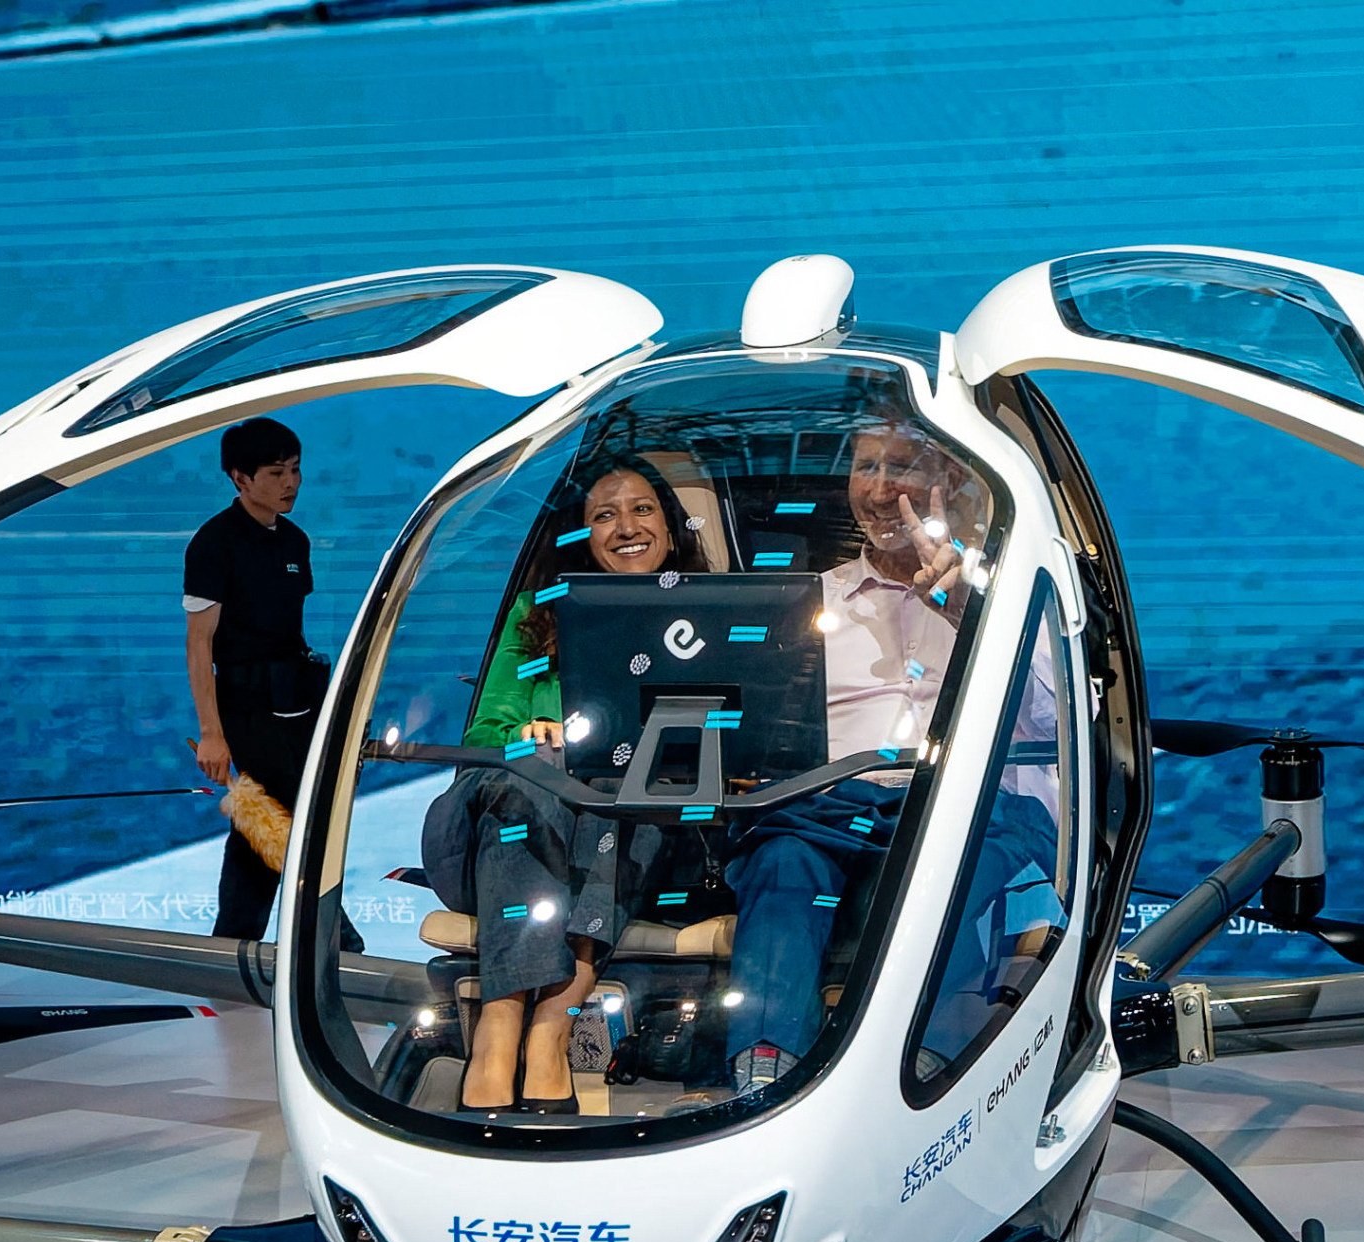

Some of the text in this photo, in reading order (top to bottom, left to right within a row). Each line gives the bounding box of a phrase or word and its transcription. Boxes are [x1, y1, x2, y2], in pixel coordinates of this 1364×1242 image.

[900, 1132, 972, 1203] CHANGAN
[903, 1109, 973, 1188] 长安汽车
